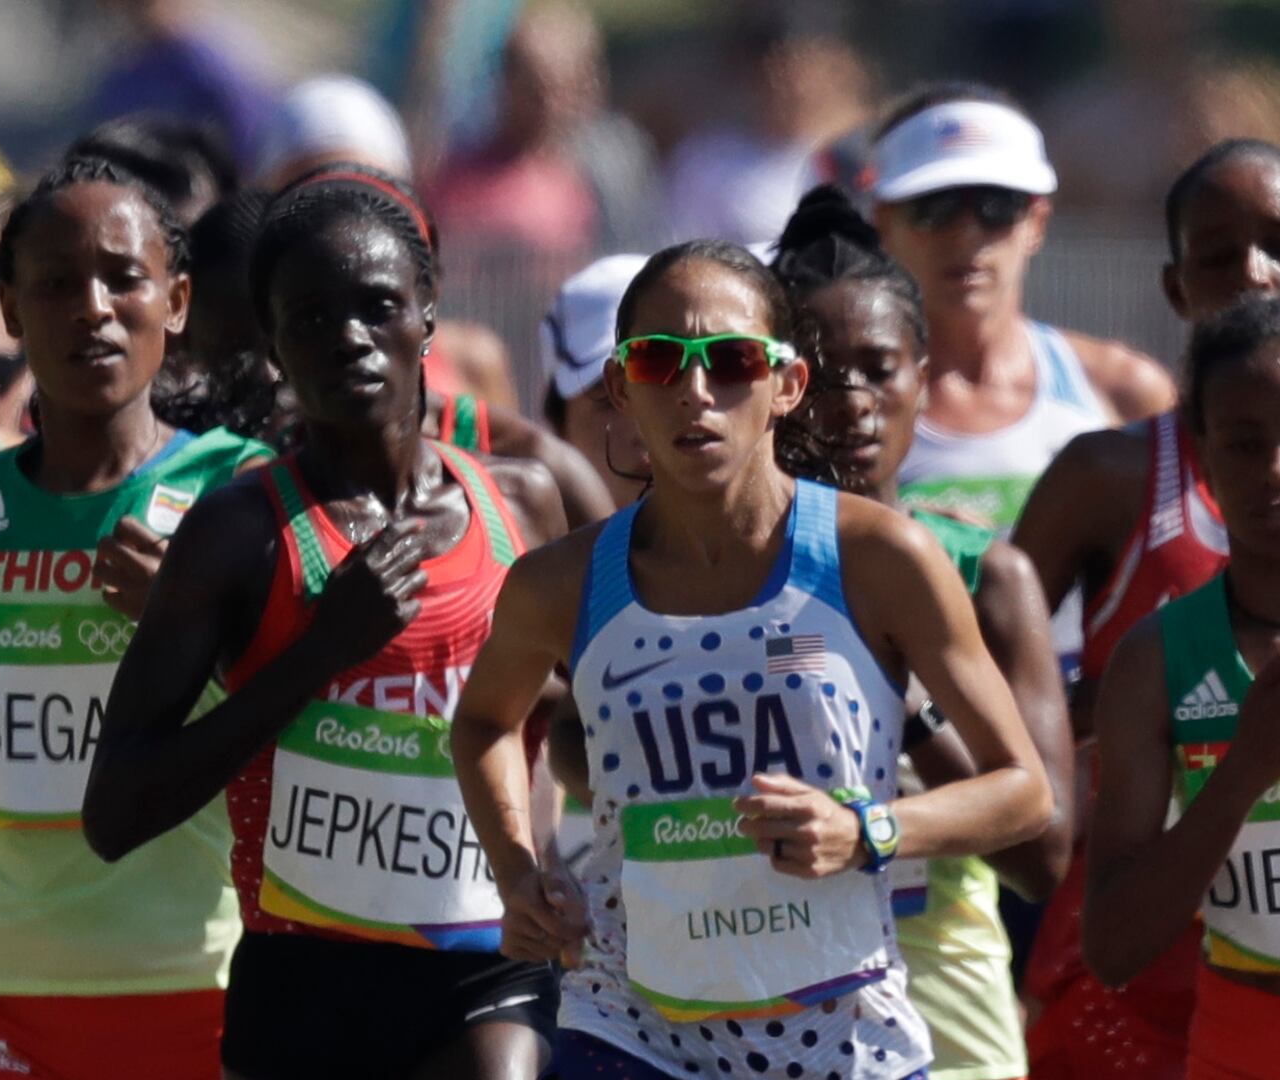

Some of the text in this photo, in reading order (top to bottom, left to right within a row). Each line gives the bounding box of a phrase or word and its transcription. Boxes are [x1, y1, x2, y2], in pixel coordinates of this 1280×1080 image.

[1174, 701, 1240, 721] adidas
[315, 717, 421, 760] Rio2016
[633, 694, 804, 795] USA
[687, 899, 813, 941] LINDEN
